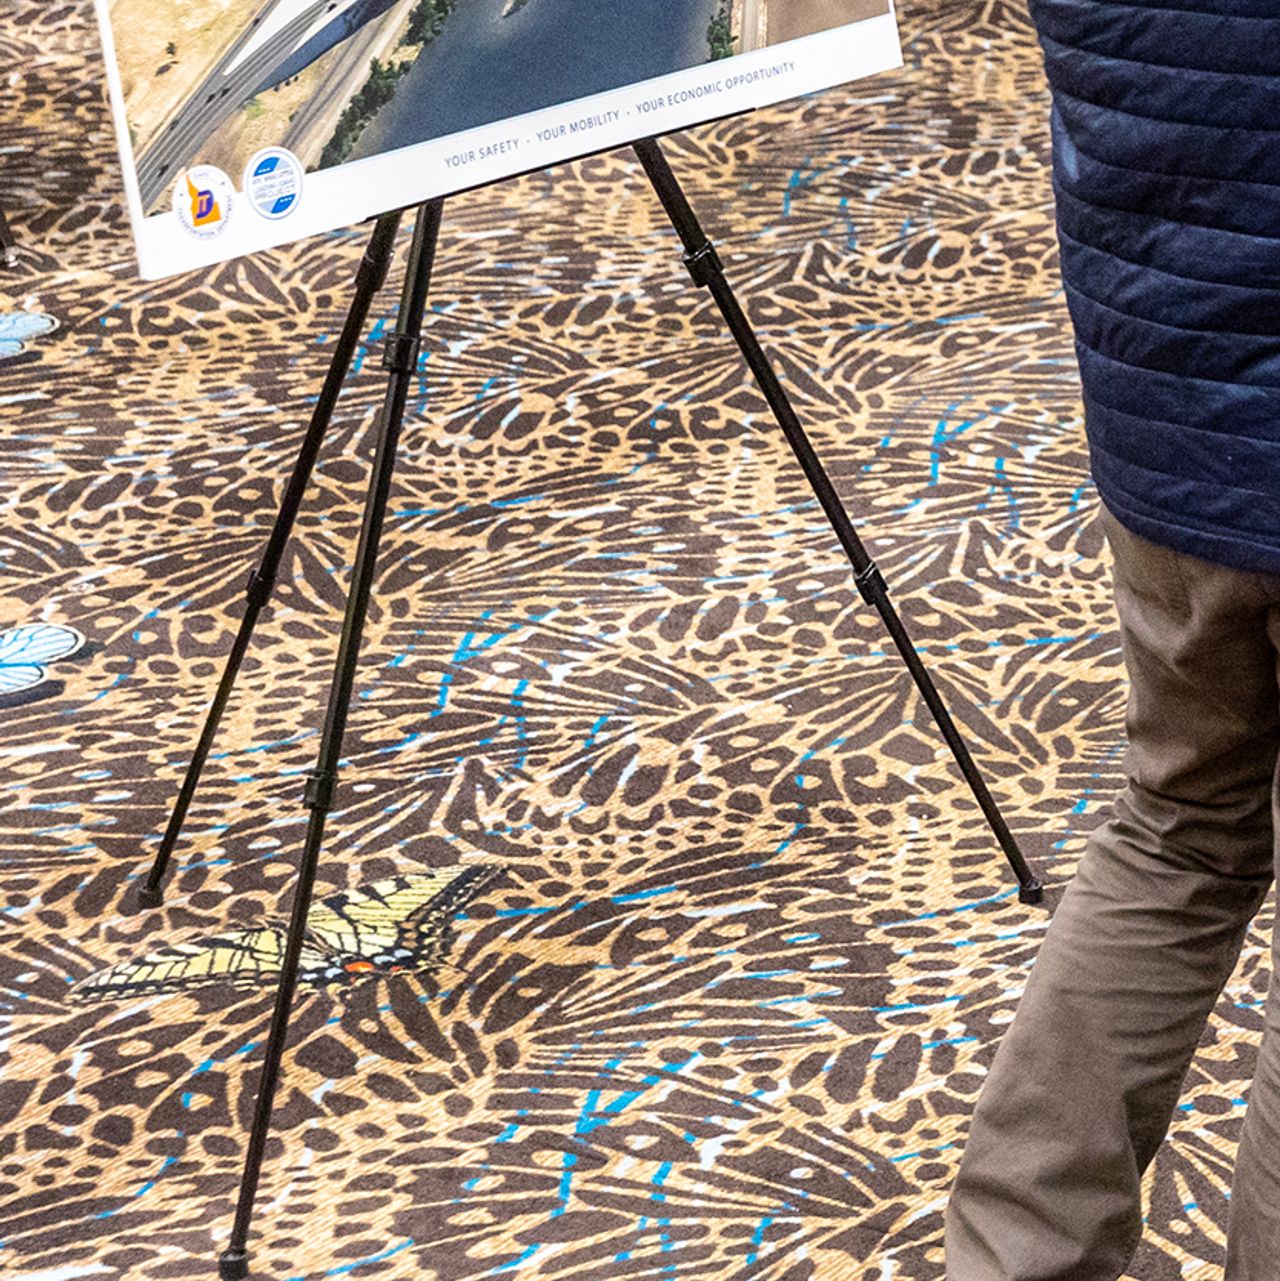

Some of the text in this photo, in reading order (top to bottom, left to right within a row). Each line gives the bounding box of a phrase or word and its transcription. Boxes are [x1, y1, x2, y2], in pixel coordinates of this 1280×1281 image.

[444, 61, 795, 168] YOUR SAFETY YOUR MOBILITY YOUR ECONOMIC OPPORTUNITY
